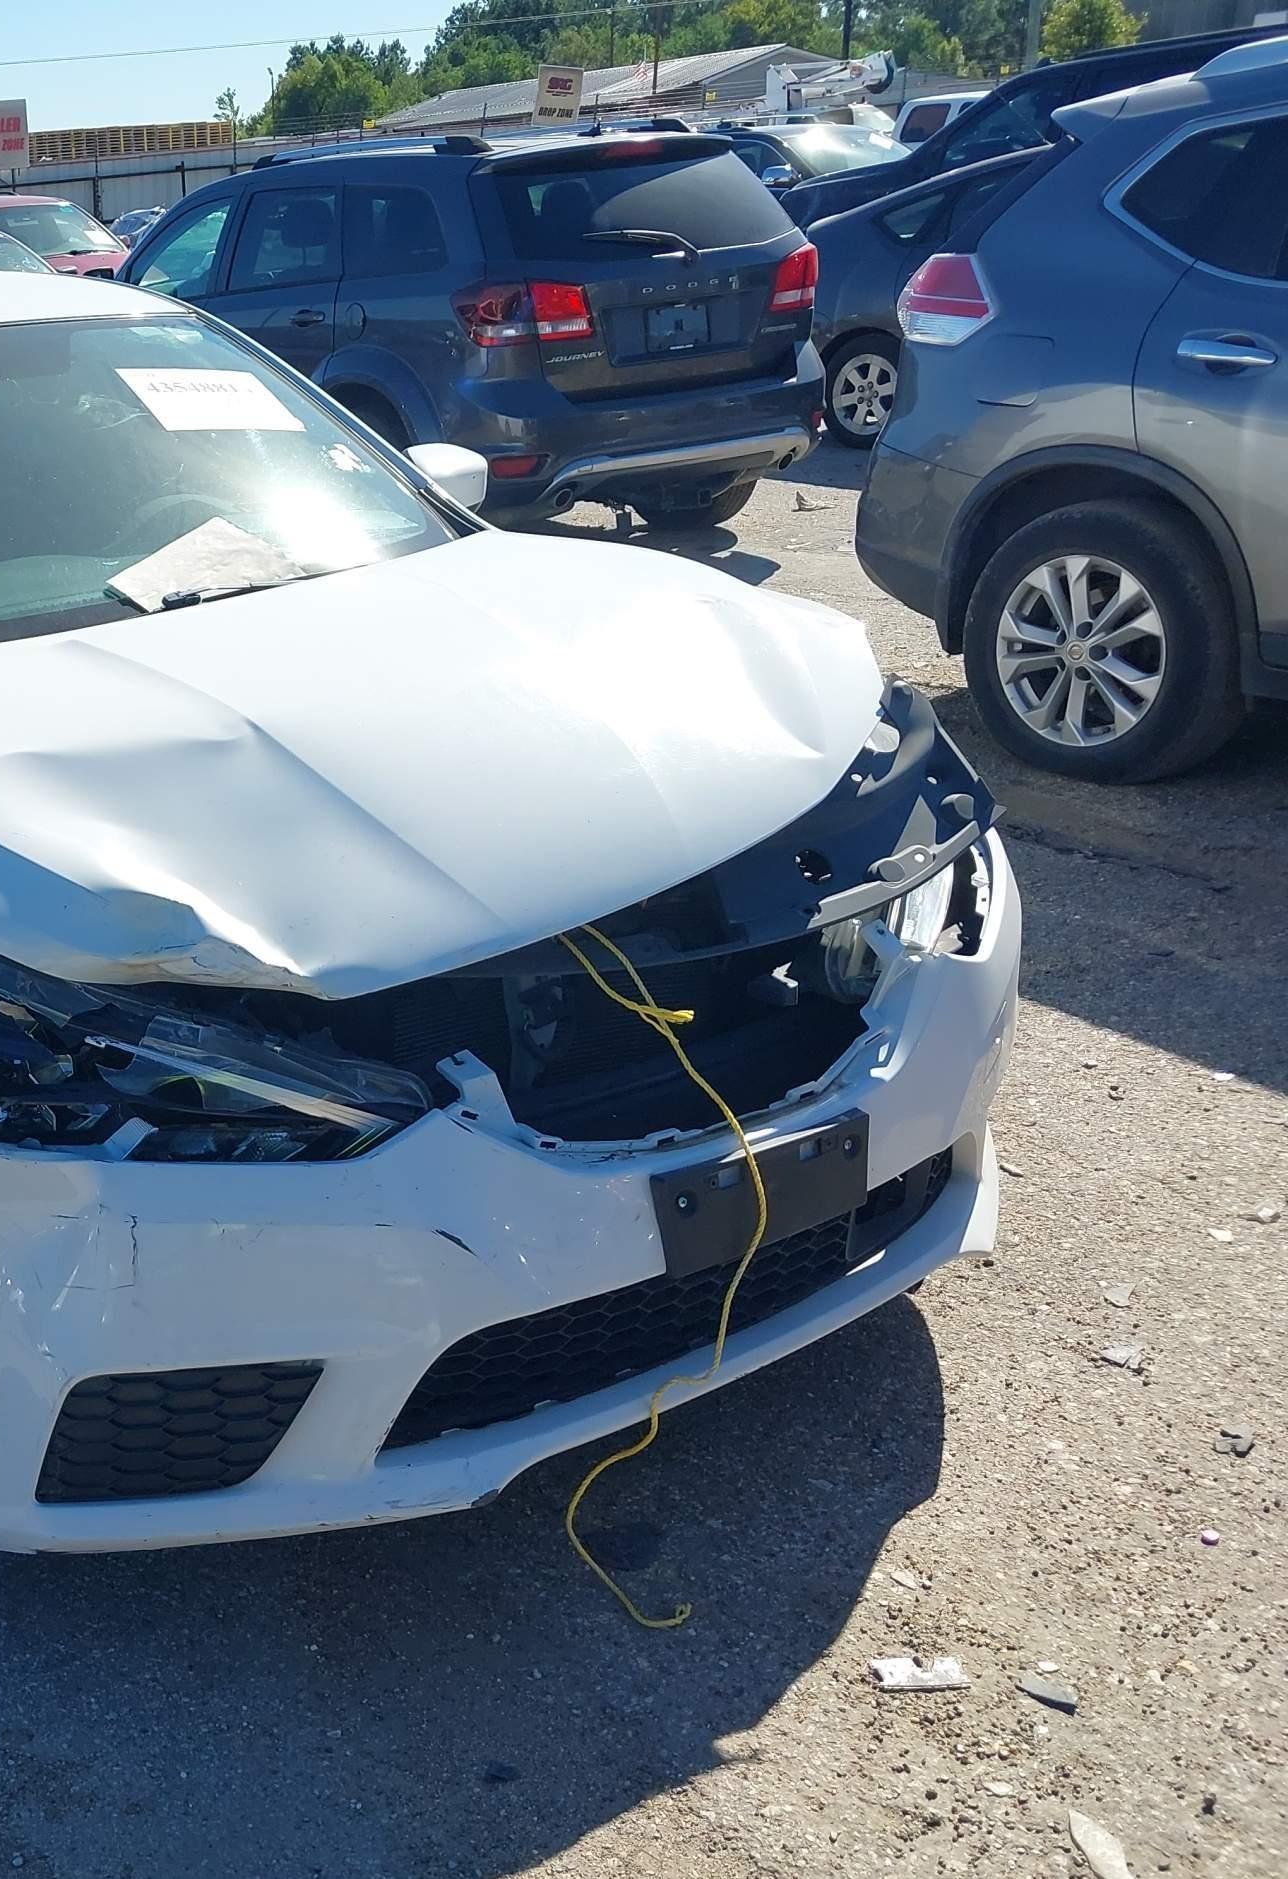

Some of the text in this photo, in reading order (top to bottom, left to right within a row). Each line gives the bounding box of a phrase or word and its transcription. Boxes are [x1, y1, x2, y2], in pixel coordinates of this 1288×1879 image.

[2, 138, 25, 151] ZONE
[642, 274, 739, 294] DODGE
[545, 350, 605, 363] JOURNEY
